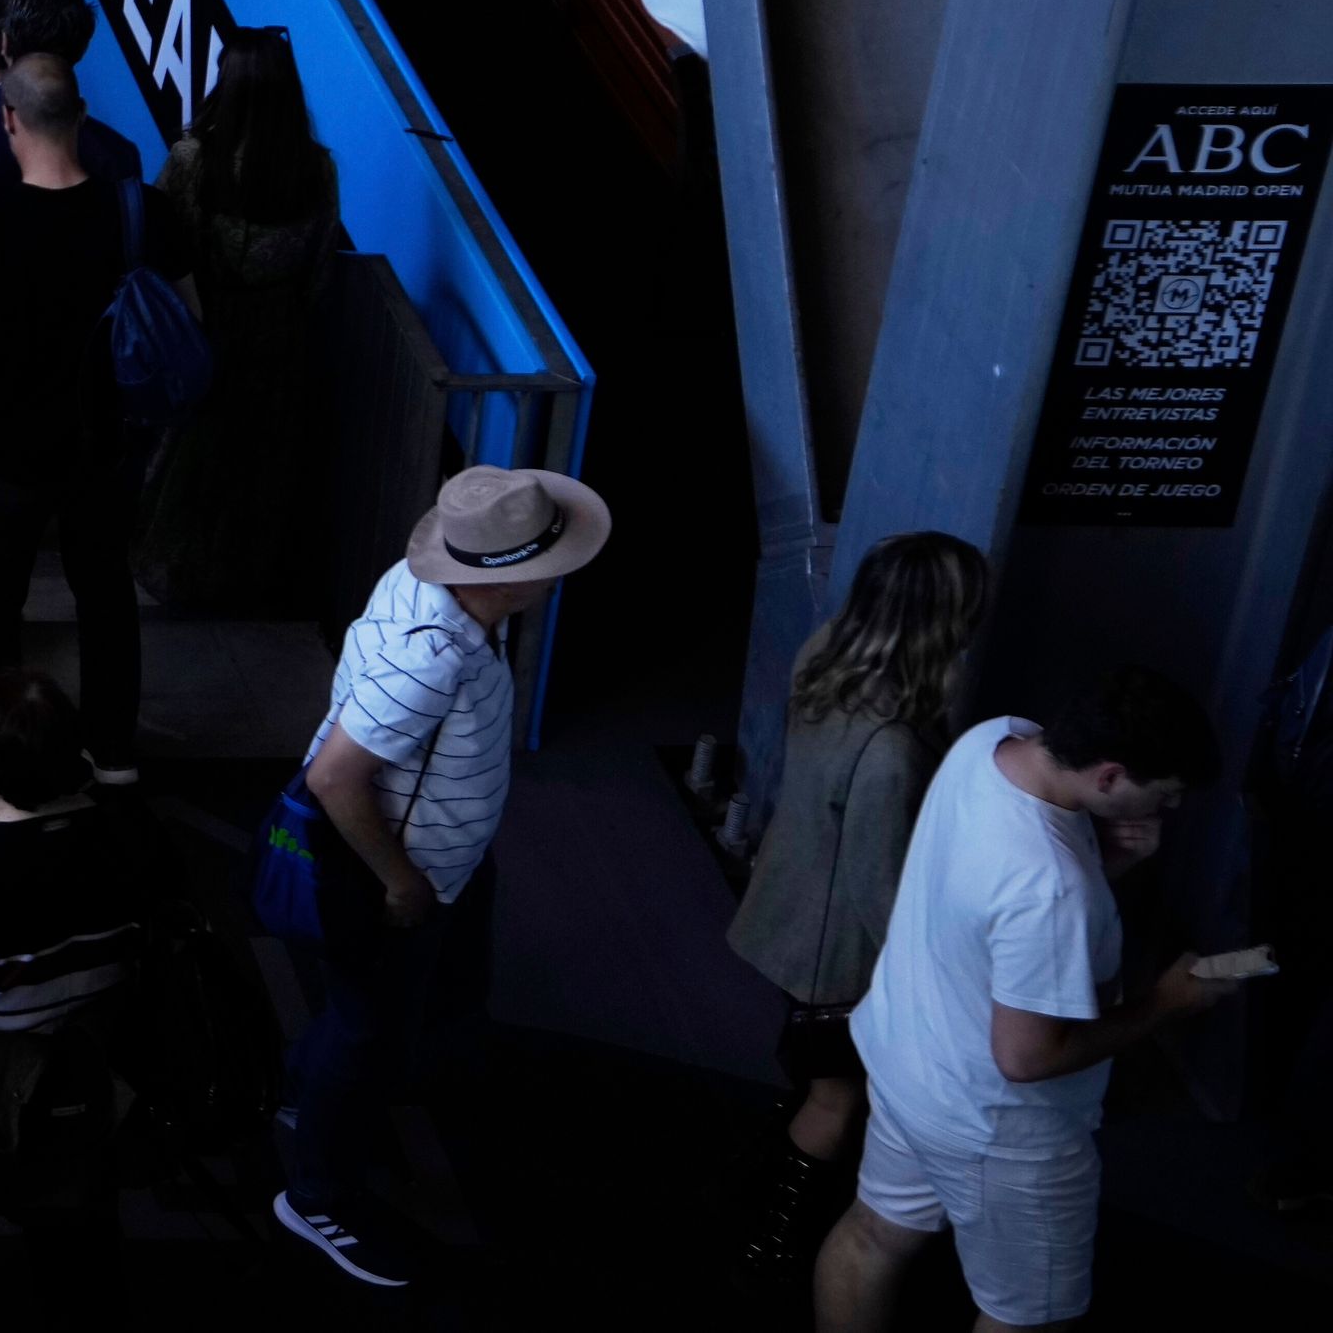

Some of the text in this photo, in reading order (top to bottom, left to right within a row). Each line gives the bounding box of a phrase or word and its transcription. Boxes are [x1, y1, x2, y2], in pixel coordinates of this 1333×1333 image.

[1174, 102, 1280, 116] ACCEDE AQUÍ
[1121, 122, 1311, 174] ABC
[1108, 184, 1305, 197] MUTUA MADRID OPEN
[1084, 386, 1229, 401] LAS MEJORES
[1081, 406, 1221, 421] ENTREVISTAS
[1068, 434, 1219, 451] INFORMACIÓN
[1071, 455, 1206, 470] DEL TORNEO
[1042, 482, 1222, 498] ORDEN DE JUEGO
